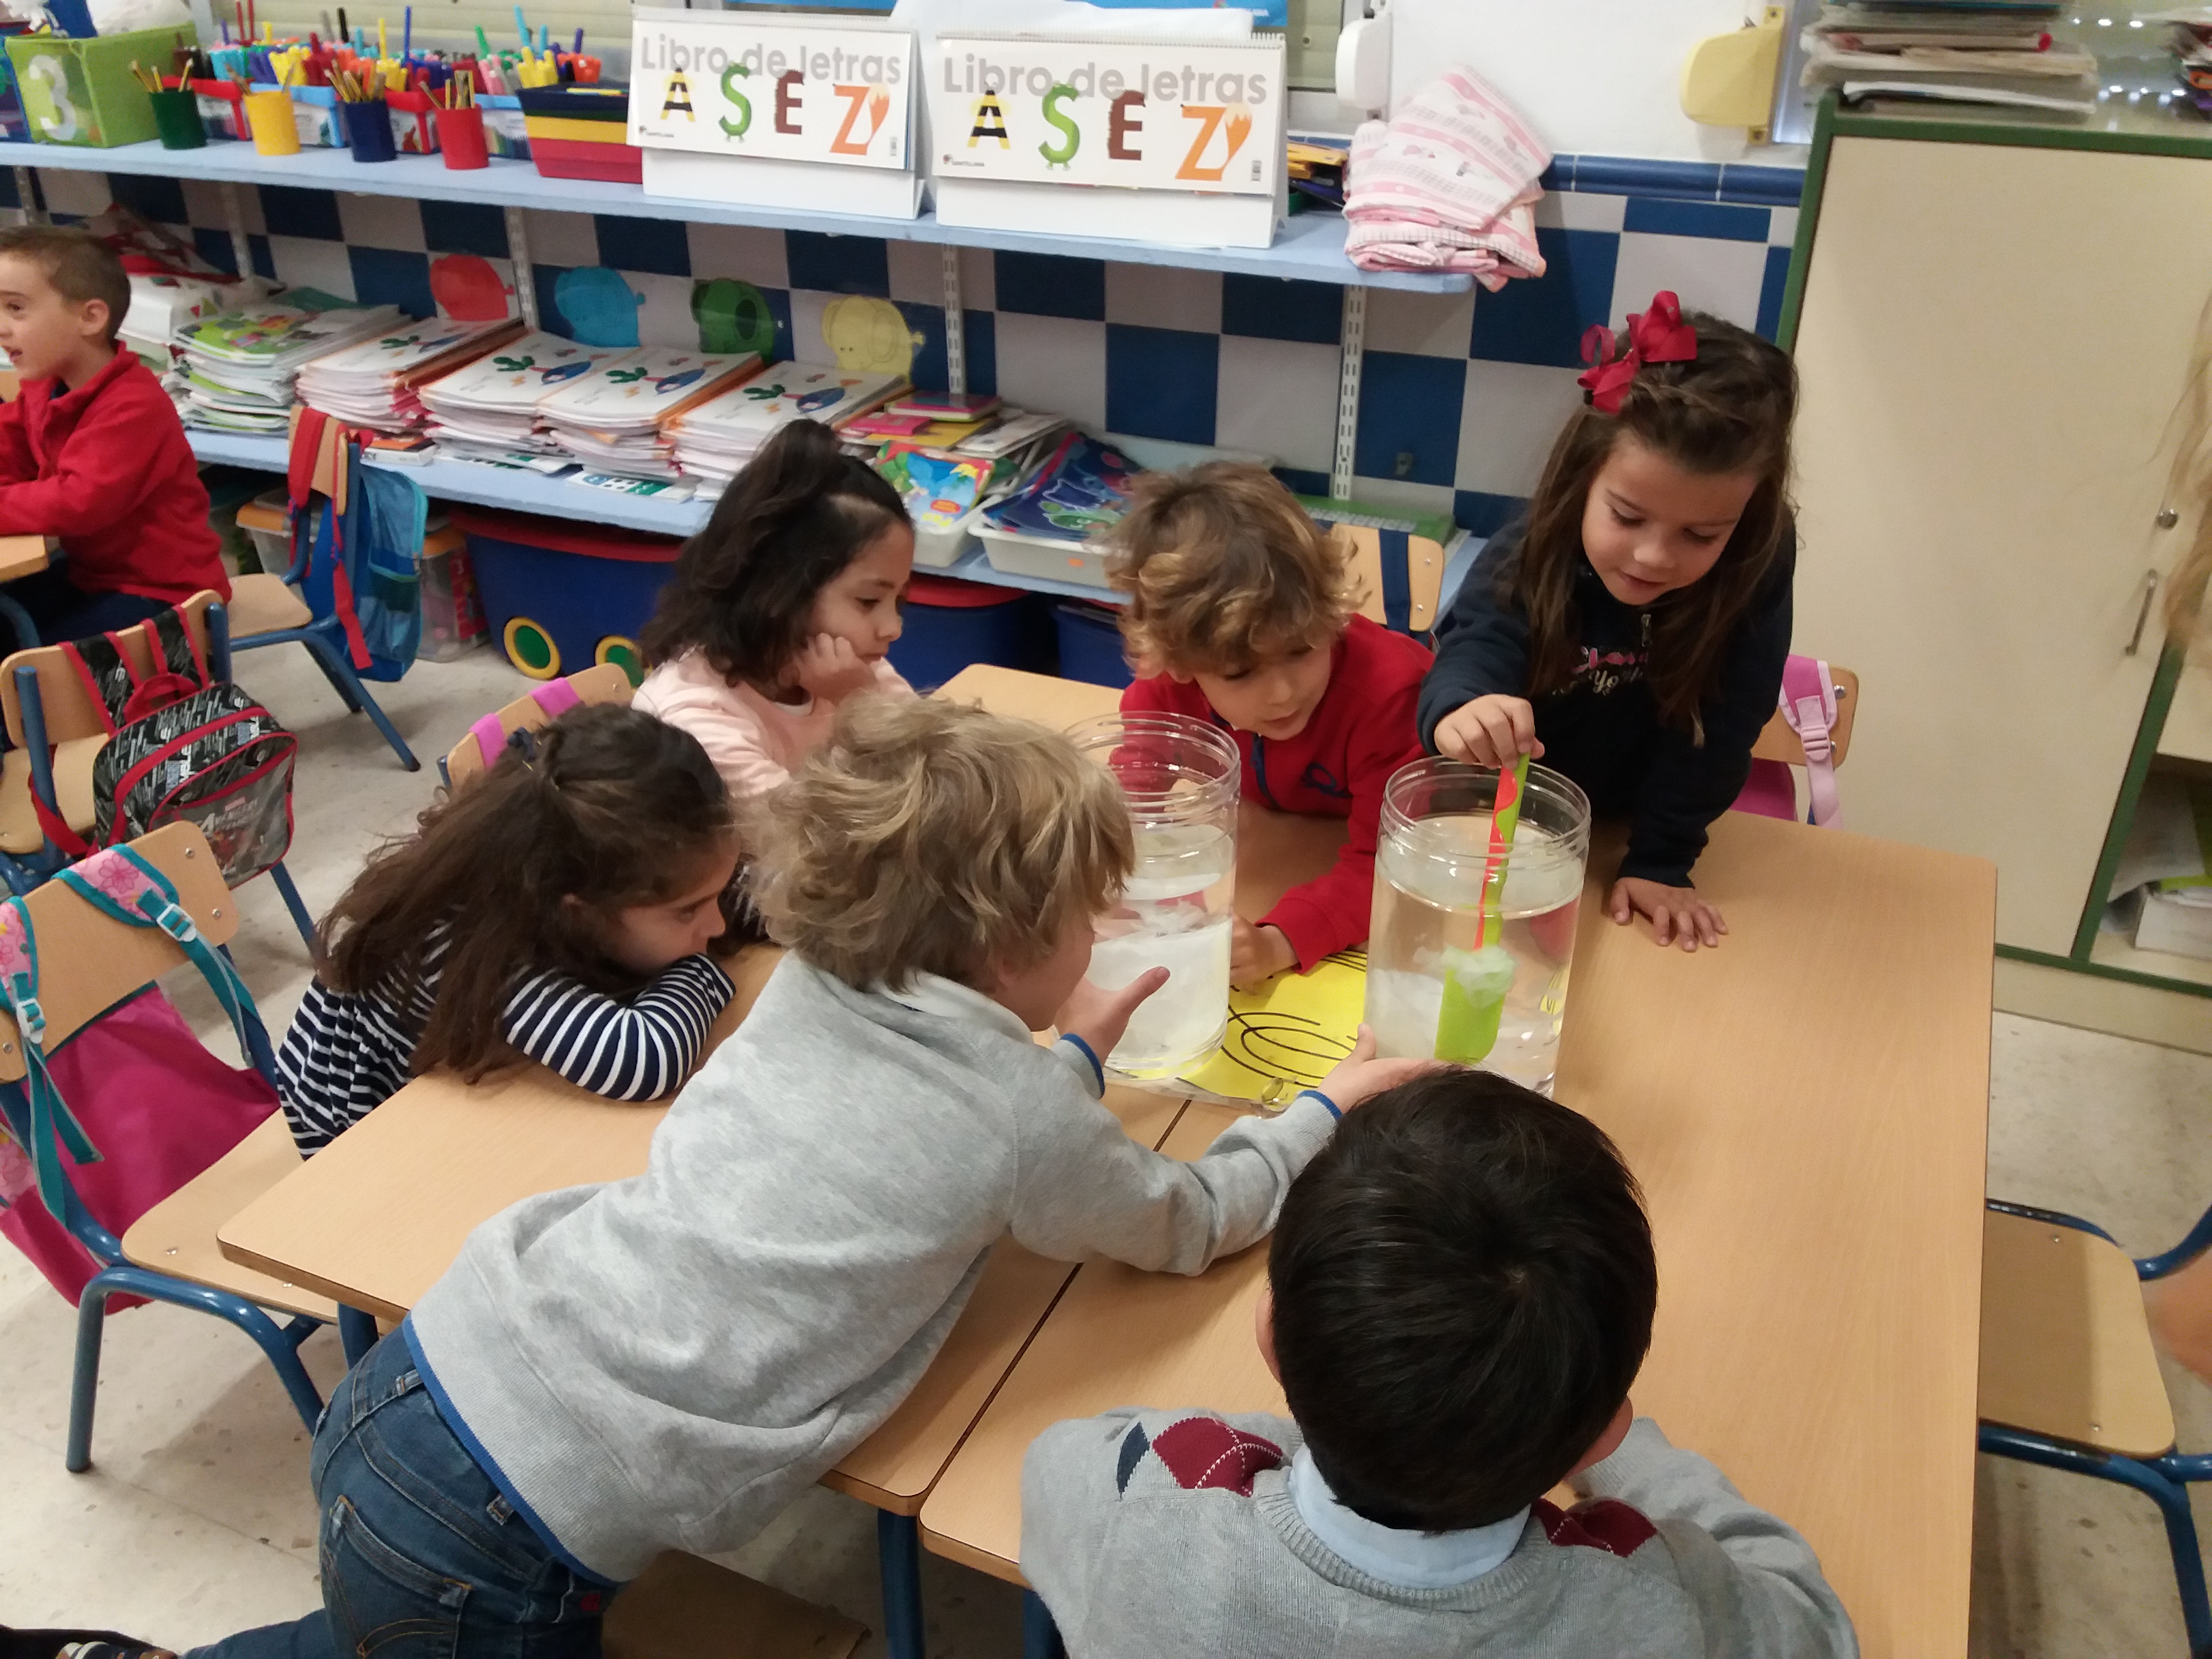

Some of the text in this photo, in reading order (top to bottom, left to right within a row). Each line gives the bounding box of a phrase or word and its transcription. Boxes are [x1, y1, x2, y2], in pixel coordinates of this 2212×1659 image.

[642, 33, 901, 85] Libro de letras
[944, 53, 1267, 104] Libro de letras
[660, 66, 696, 123] A
[718, 62, 752, 138] S
[774, 69, 804, 135] E
[967, 89, 1011, 150] A
[1038, 82, 1080, 165] S
[1107, 89, 1146, 161] E
